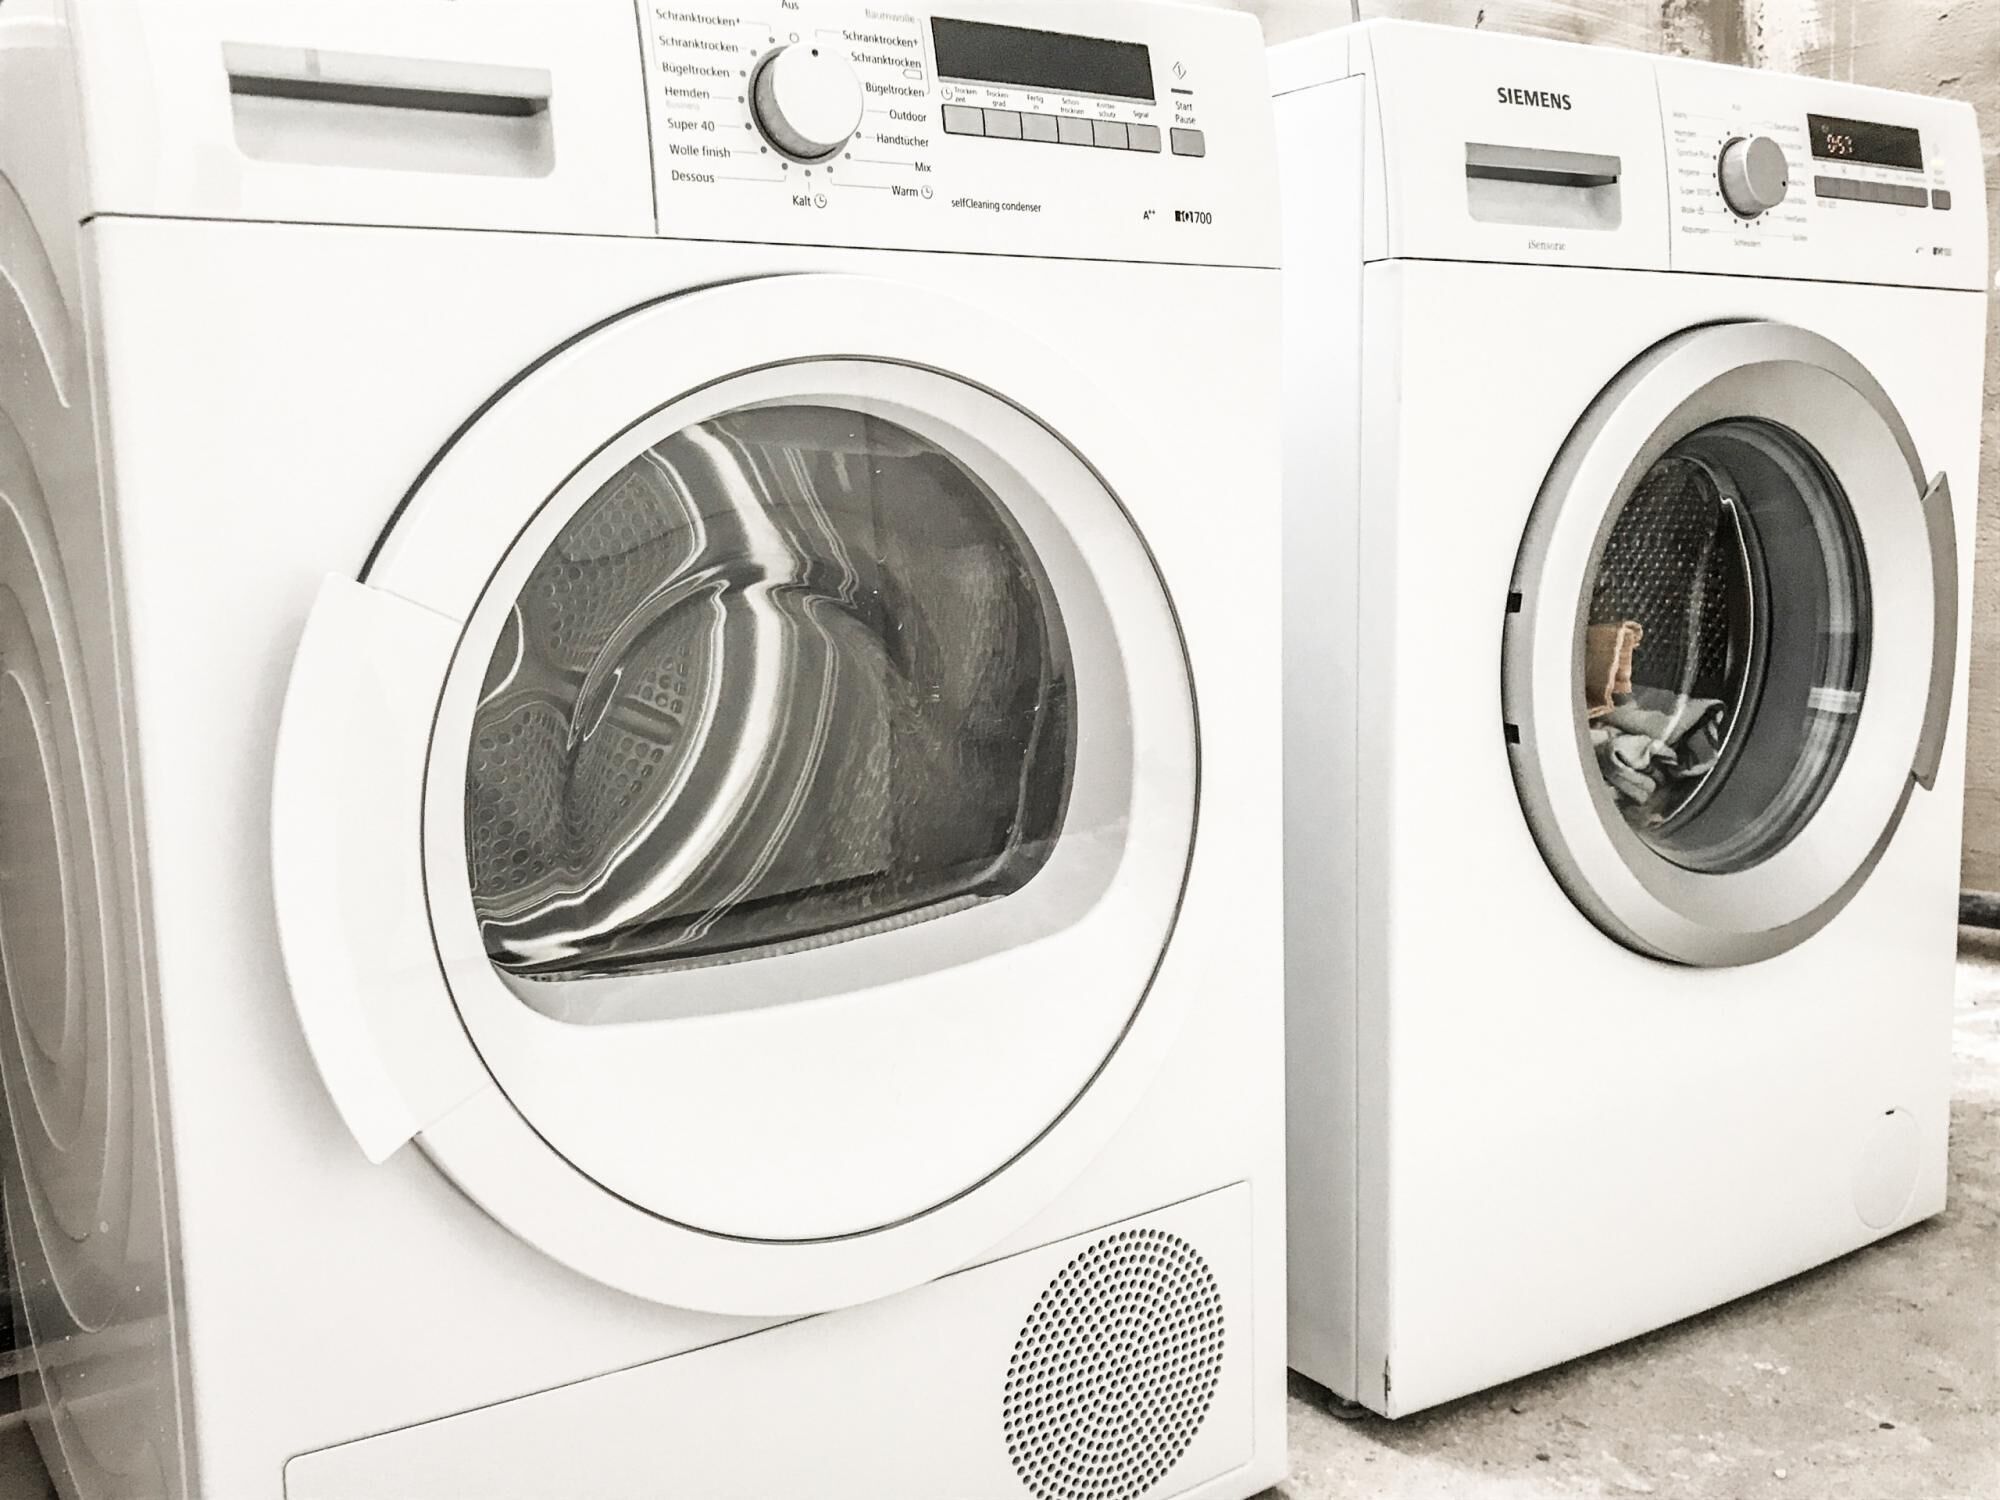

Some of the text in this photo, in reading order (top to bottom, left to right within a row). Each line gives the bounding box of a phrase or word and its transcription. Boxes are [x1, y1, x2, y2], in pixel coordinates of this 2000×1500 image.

[658, 35, 739, 53] Schranktrocken
[850, 51, 922, 69] Schranktrocken
[661, 61, 730, 78] Bügeltrocken
[664, 85, 710, 100] Hemden
[865, 81, 925, 98] Bügeltrocken
[1175, 100, 1193, 112] Start
[1496, 86, 1572, 111] SIEMENS
[888, 108, 927, 123] Outdoor
[1174, 113, 1197, 125] Pause
[667, 117, 716, 133] Super 40
[876, 132, 929, 148] Handtücher
[668, 143, 731, 159] Wolle finish
[914, 161, 932, 173] Mix
[671, 169, 715, 184] Dessous
[891, 184, 919, 198] Warm
[792, 194, 812, 207] Kalt
[951, 197, 1042, 213] selfCleaning condenser
